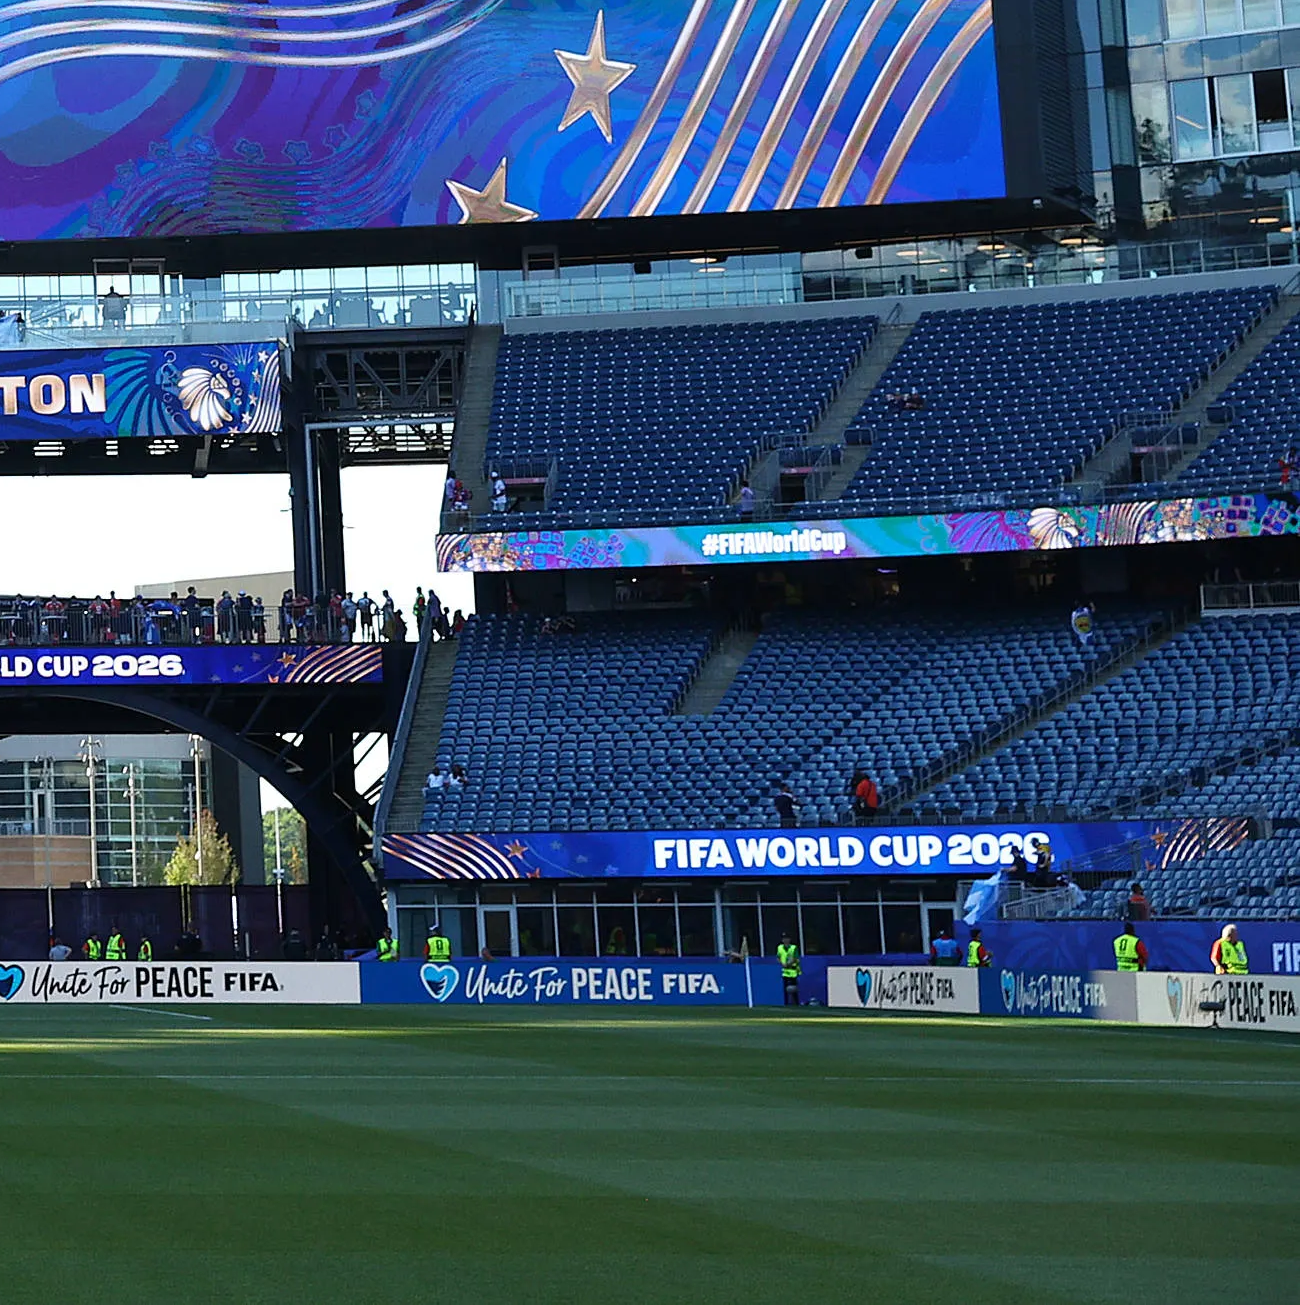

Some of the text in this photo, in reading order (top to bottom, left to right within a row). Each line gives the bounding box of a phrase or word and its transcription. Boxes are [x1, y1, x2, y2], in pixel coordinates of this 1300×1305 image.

[702, 528, 846, 556] #FIFAWorldCup
[36, 655, 89, 678] CUP
[92, 654, 183, 677] 2026
[654, 838, 734, 869] FIFA
[735, 836, 865, 868] WORLD
[869, 834, 943, 867] CUP
[31, 964, 279, 1002] Unite For PEACE FIFA
[465, 964, 720, 1004] Unite For PEACE FIFA
[909, 971, 935, 1006] PEACE
[936, 978, 955, 1000] FIFA
[1051, 975, 1083, 1014] PEACE
[1084, 982, 1107, 1008] FIFA
[1228, 981, 1266, 1023] PEACE
[1268, 990, 1297, 1016] FIFA
